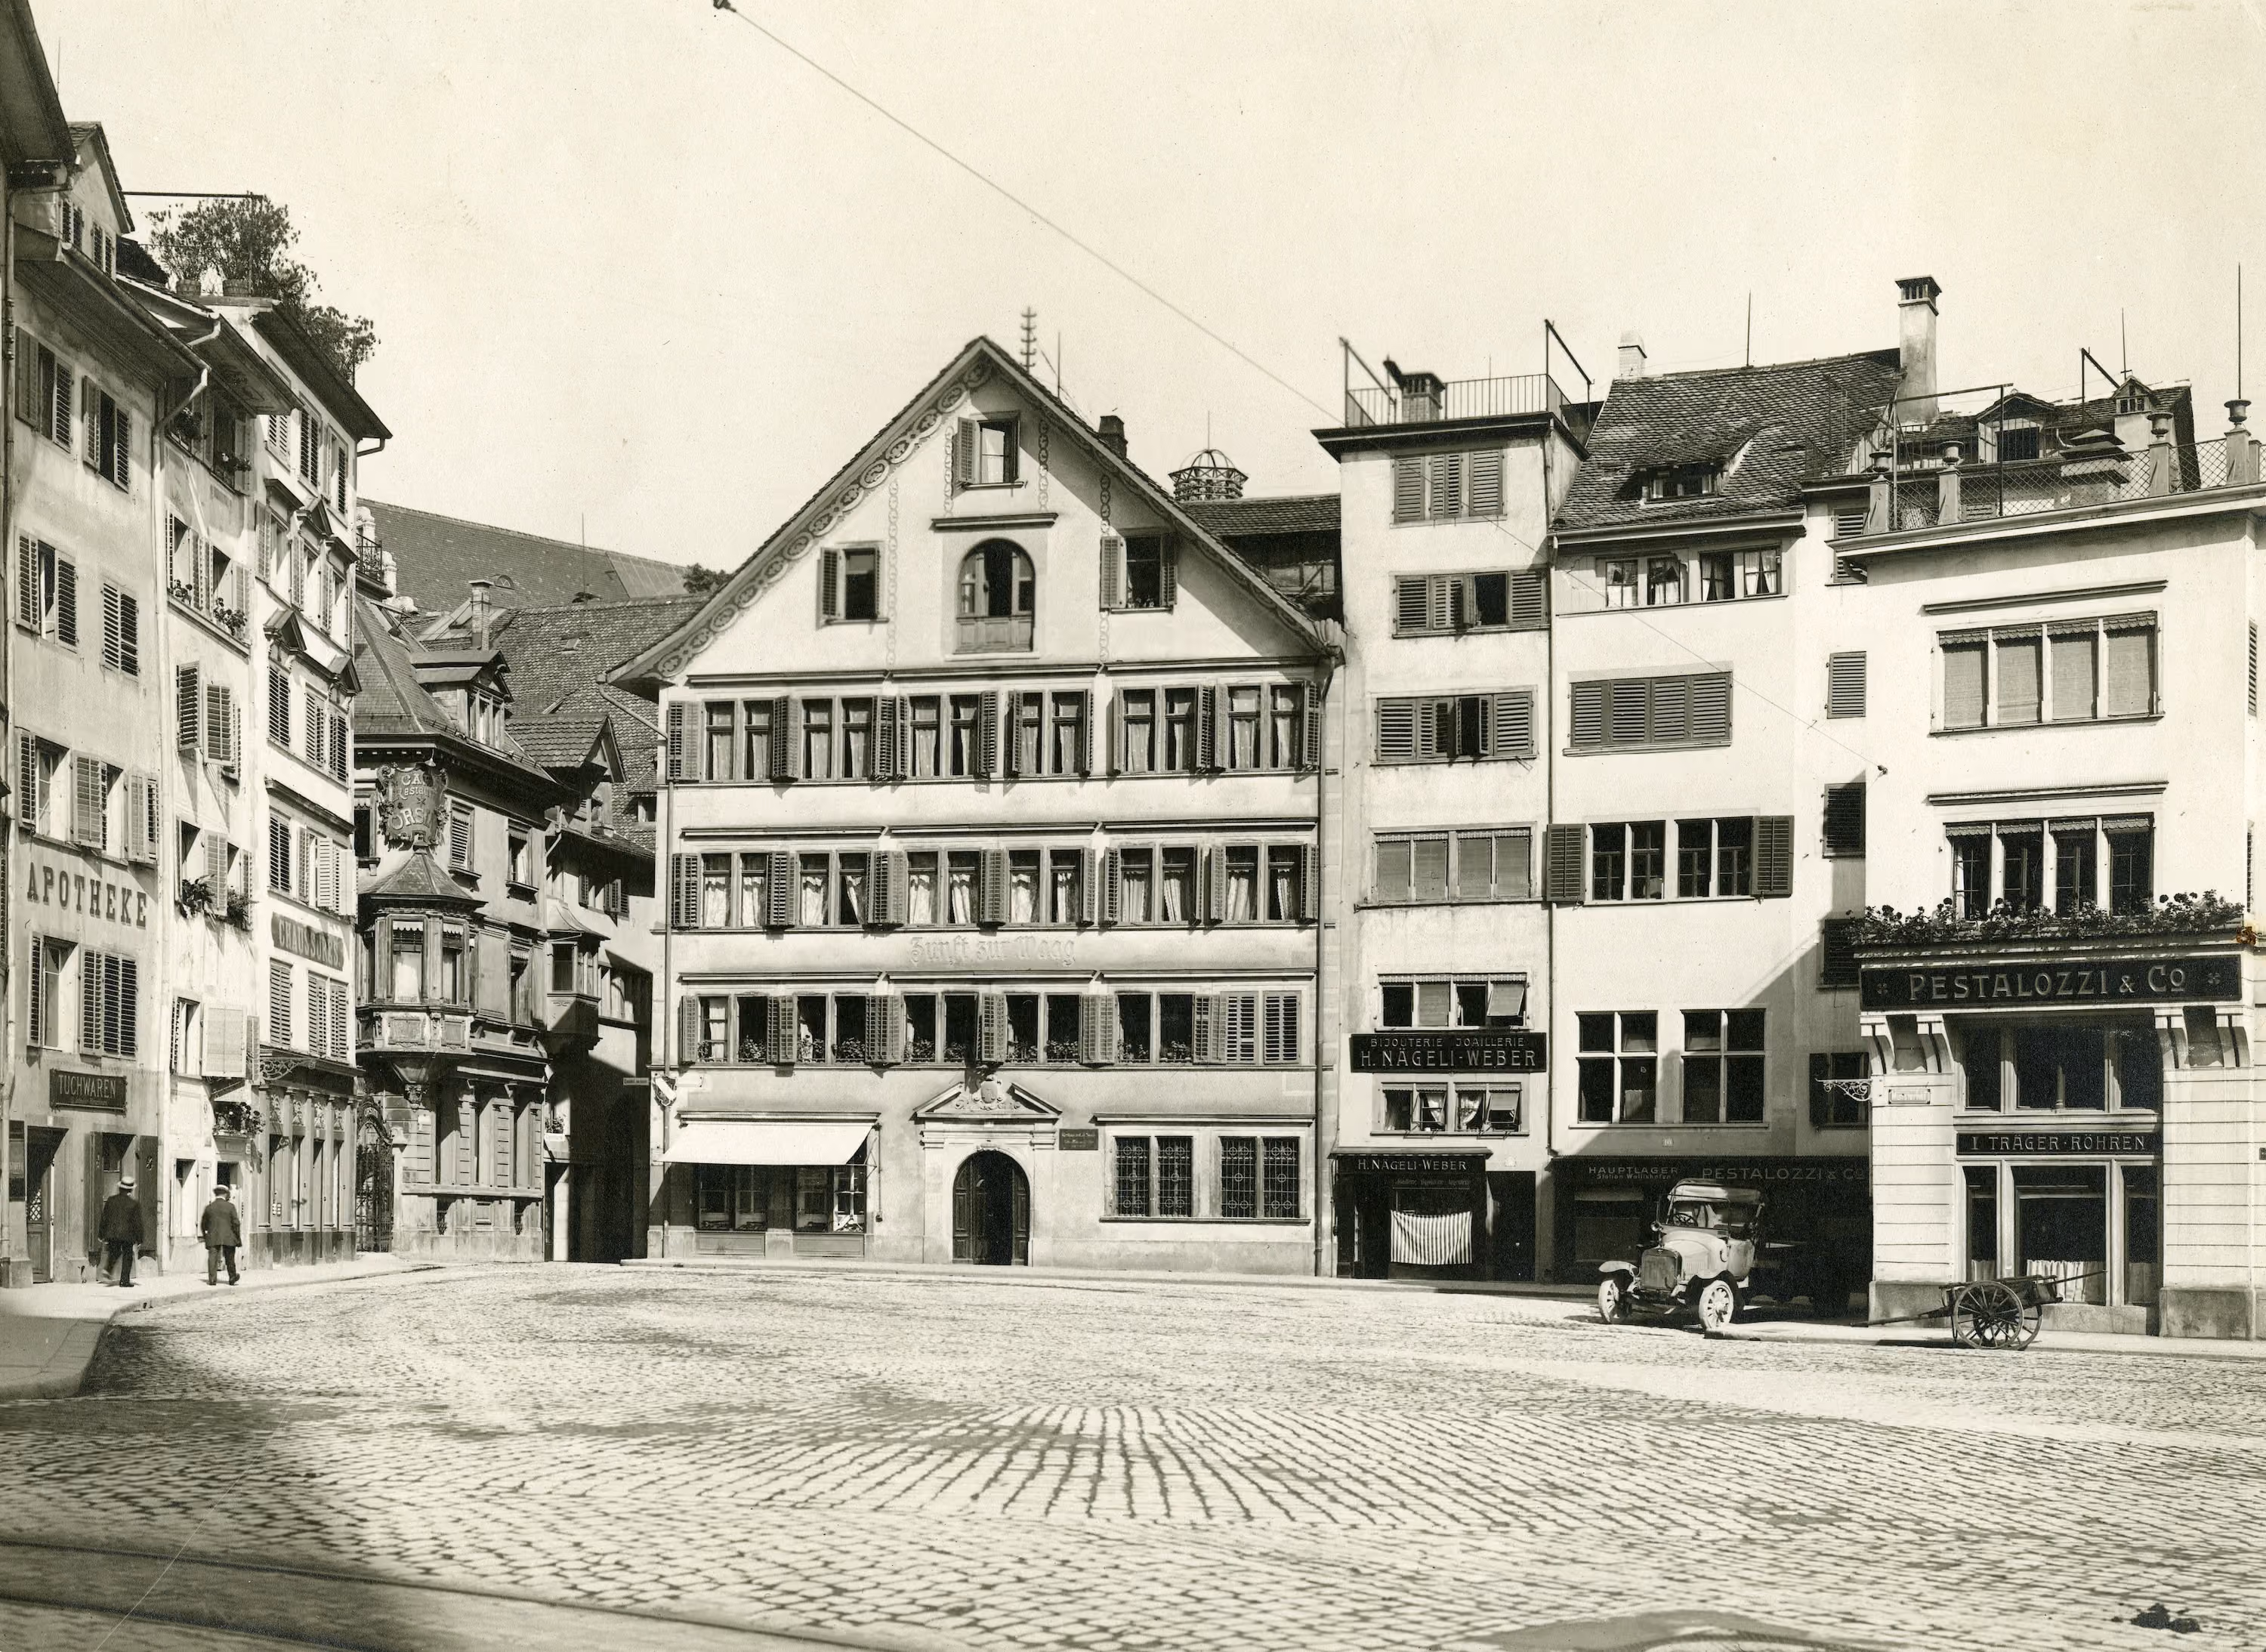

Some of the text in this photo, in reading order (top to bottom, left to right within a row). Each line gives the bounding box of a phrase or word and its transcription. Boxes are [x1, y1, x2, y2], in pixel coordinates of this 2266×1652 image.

[27, 862, 147, 928] APOTHEKE
[279, 919, 339, 966] CHAUSSURES
[909, 935, 968, 967] Zunft
[977, 940, 1011, 961] zur
[1909, 971, 2108, 1001] PESTALOZZI
[2119, 975, 2135, 993] &
[1371, 1037, 1524, 1047] BIJOUTERIE JOAILLERIE
[1361, 1051, 1376, 1067] H.
[58, 1075, 116, 1099] TUCHWAREN
[1971, 1134, 2146, 1150] I TRÄGER RÖHREN
[1358, 1159, 1369, 1170] H.
[1703, 1168, 1821, 1180] PESTALOZZI
[1827, 1171, 1837, 1179] &
